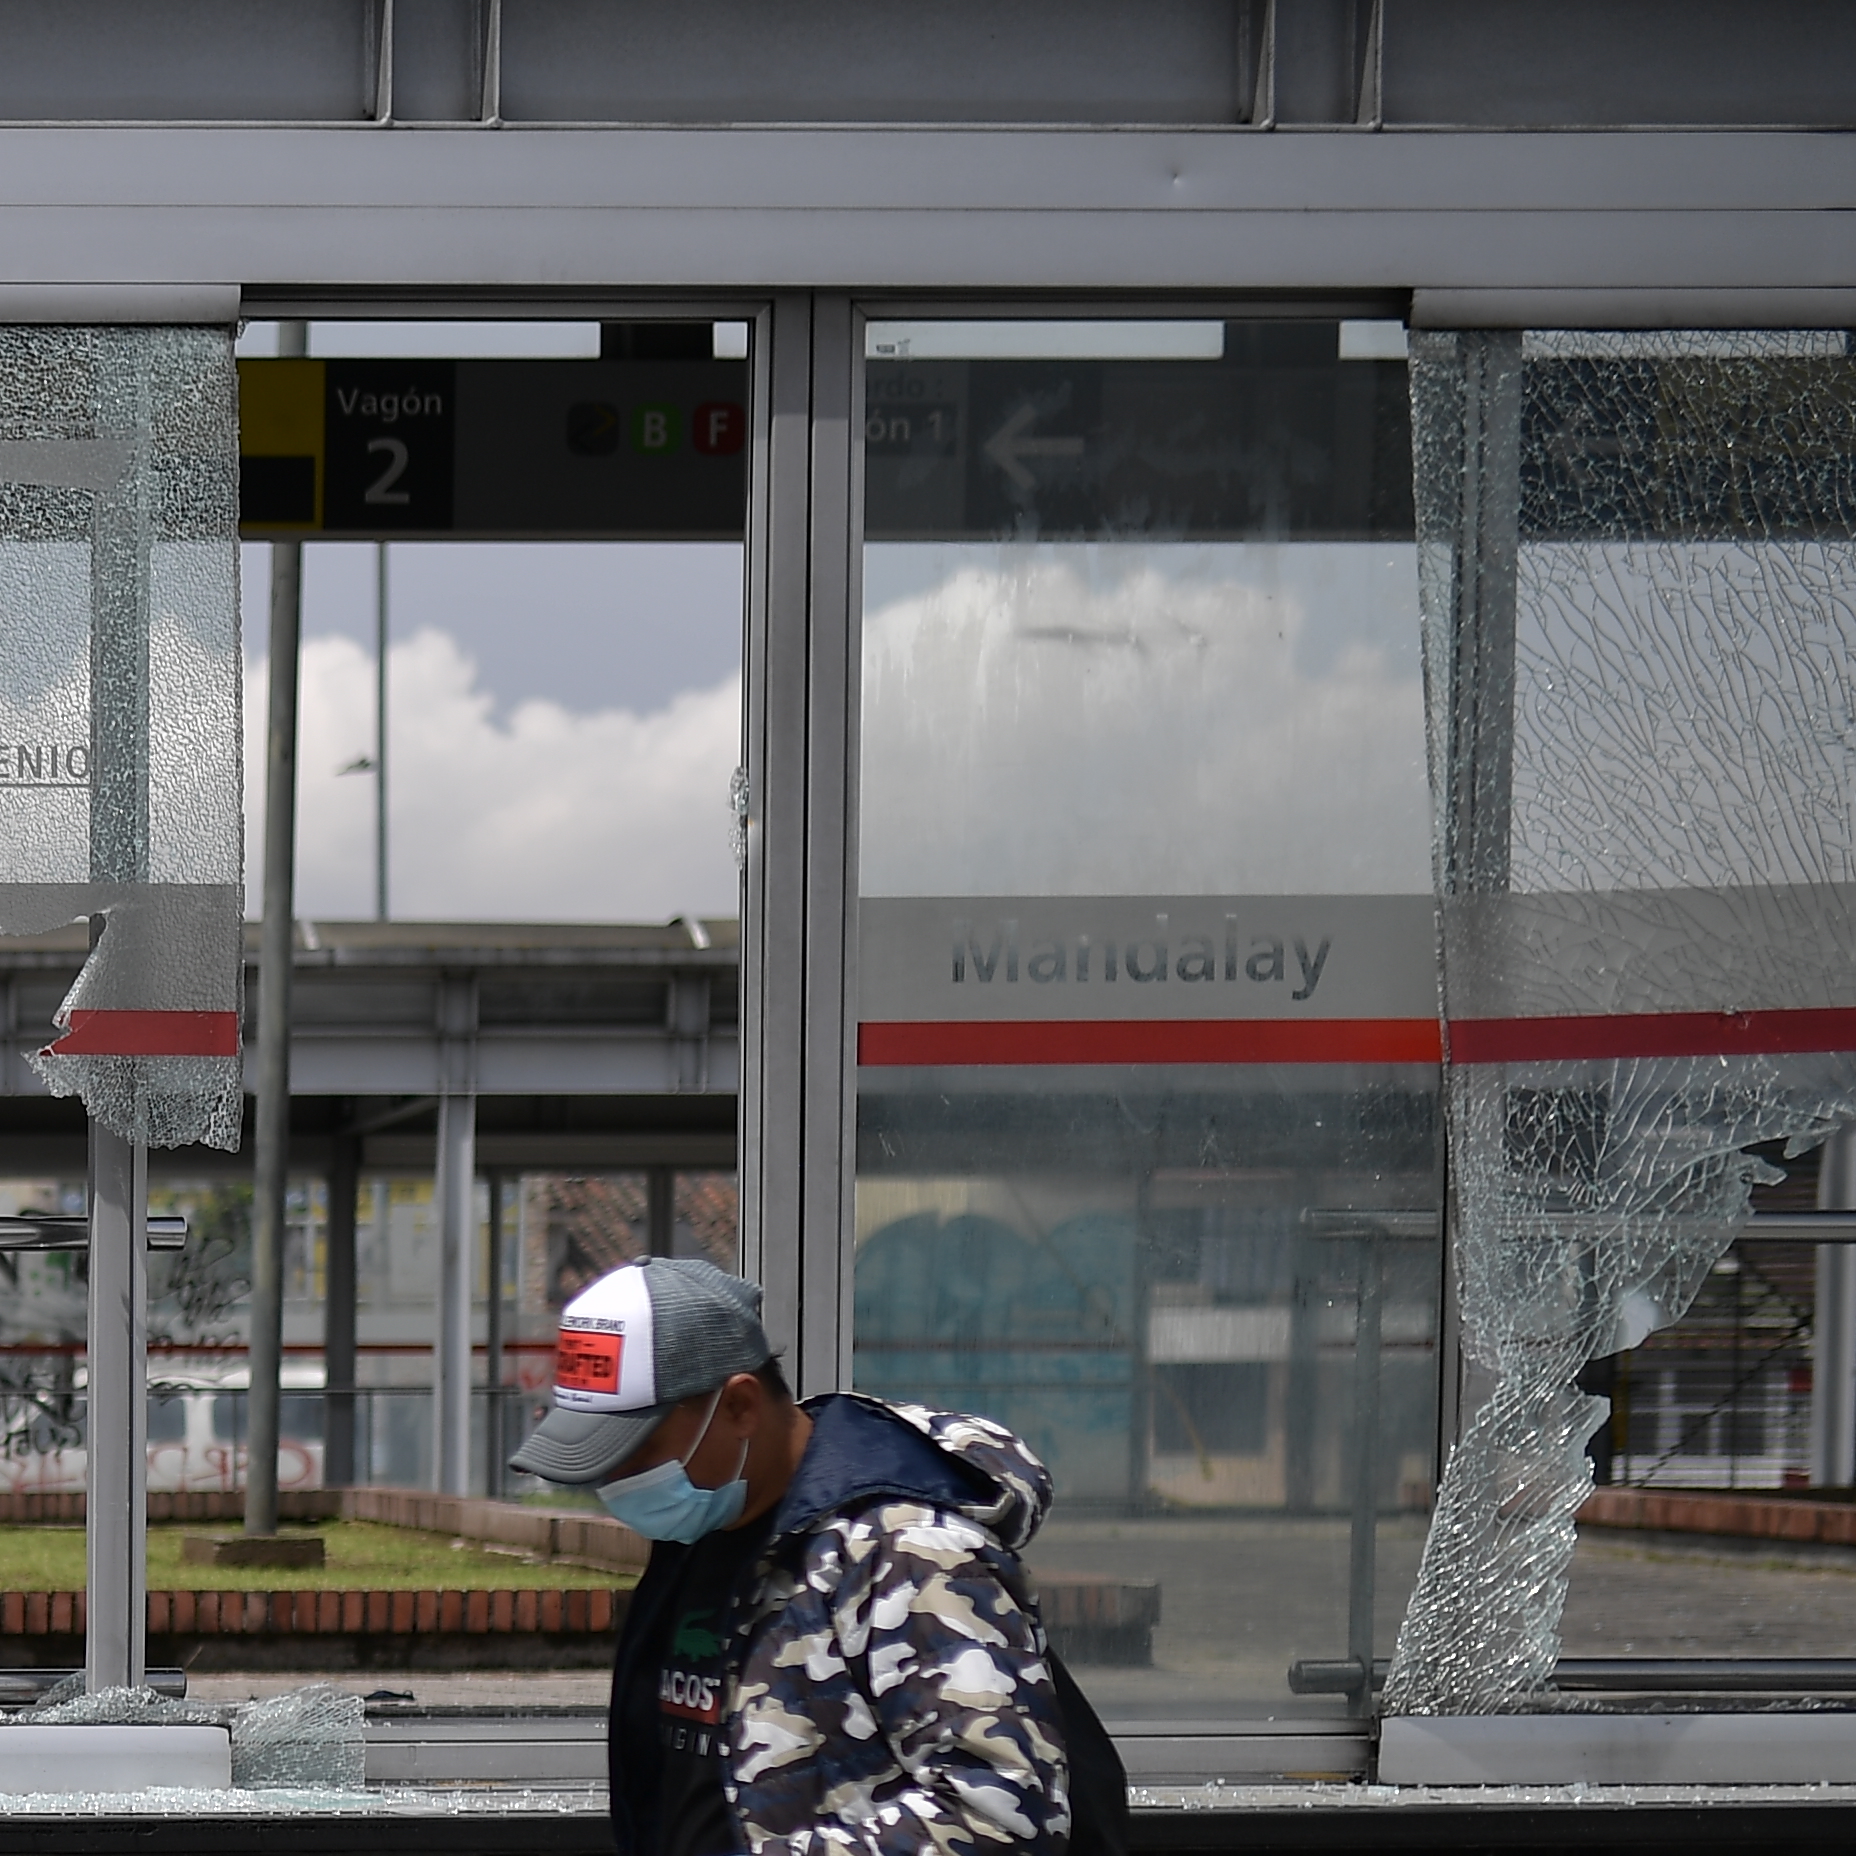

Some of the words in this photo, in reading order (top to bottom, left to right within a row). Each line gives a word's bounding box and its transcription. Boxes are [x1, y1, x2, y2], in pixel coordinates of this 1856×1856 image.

[337, 387, 443, 418] Vagón
[643, 412, 668, 448] B
[708, 412, 729, 448] F
[928, 409, 943, 442] 1
[363, 437, 411, 504] 2
[950, 913, 1334, 1001] Mandalay
